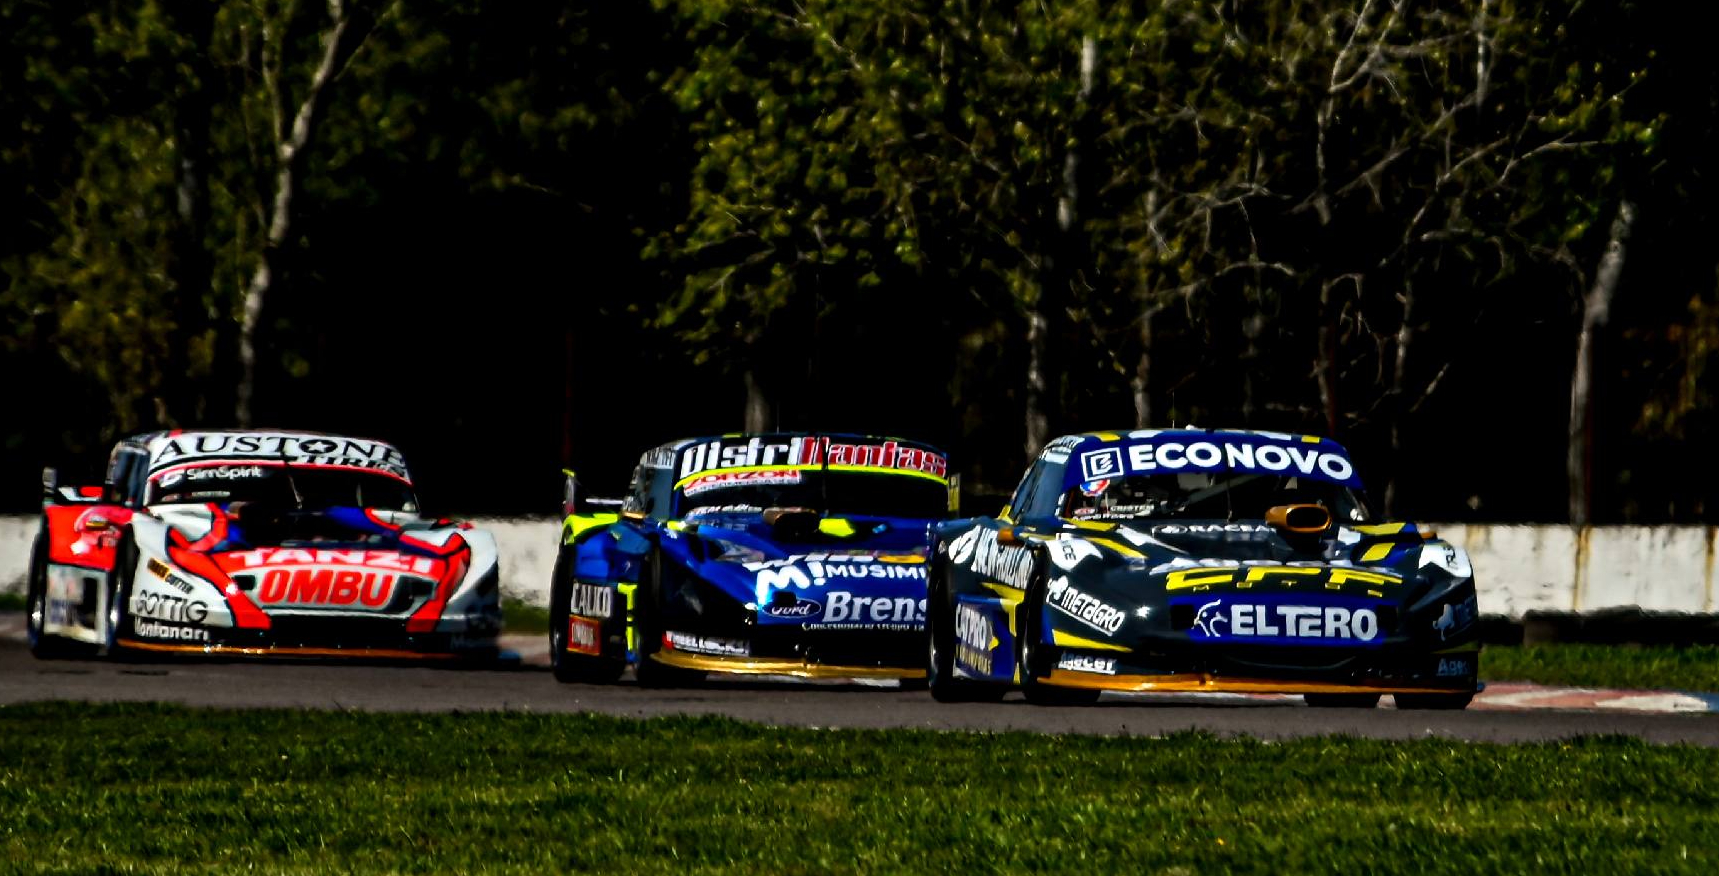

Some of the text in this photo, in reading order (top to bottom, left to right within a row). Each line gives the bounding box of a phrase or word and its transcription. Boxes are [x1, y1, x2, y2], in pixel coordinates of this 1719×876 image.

[187, 465, 262, 480] SimSpirit
[1129, 441, 1353, 480] ECONOVO
[230, 547, 432, 573] TANZI
[259, 568, 394, 607] OMBU
